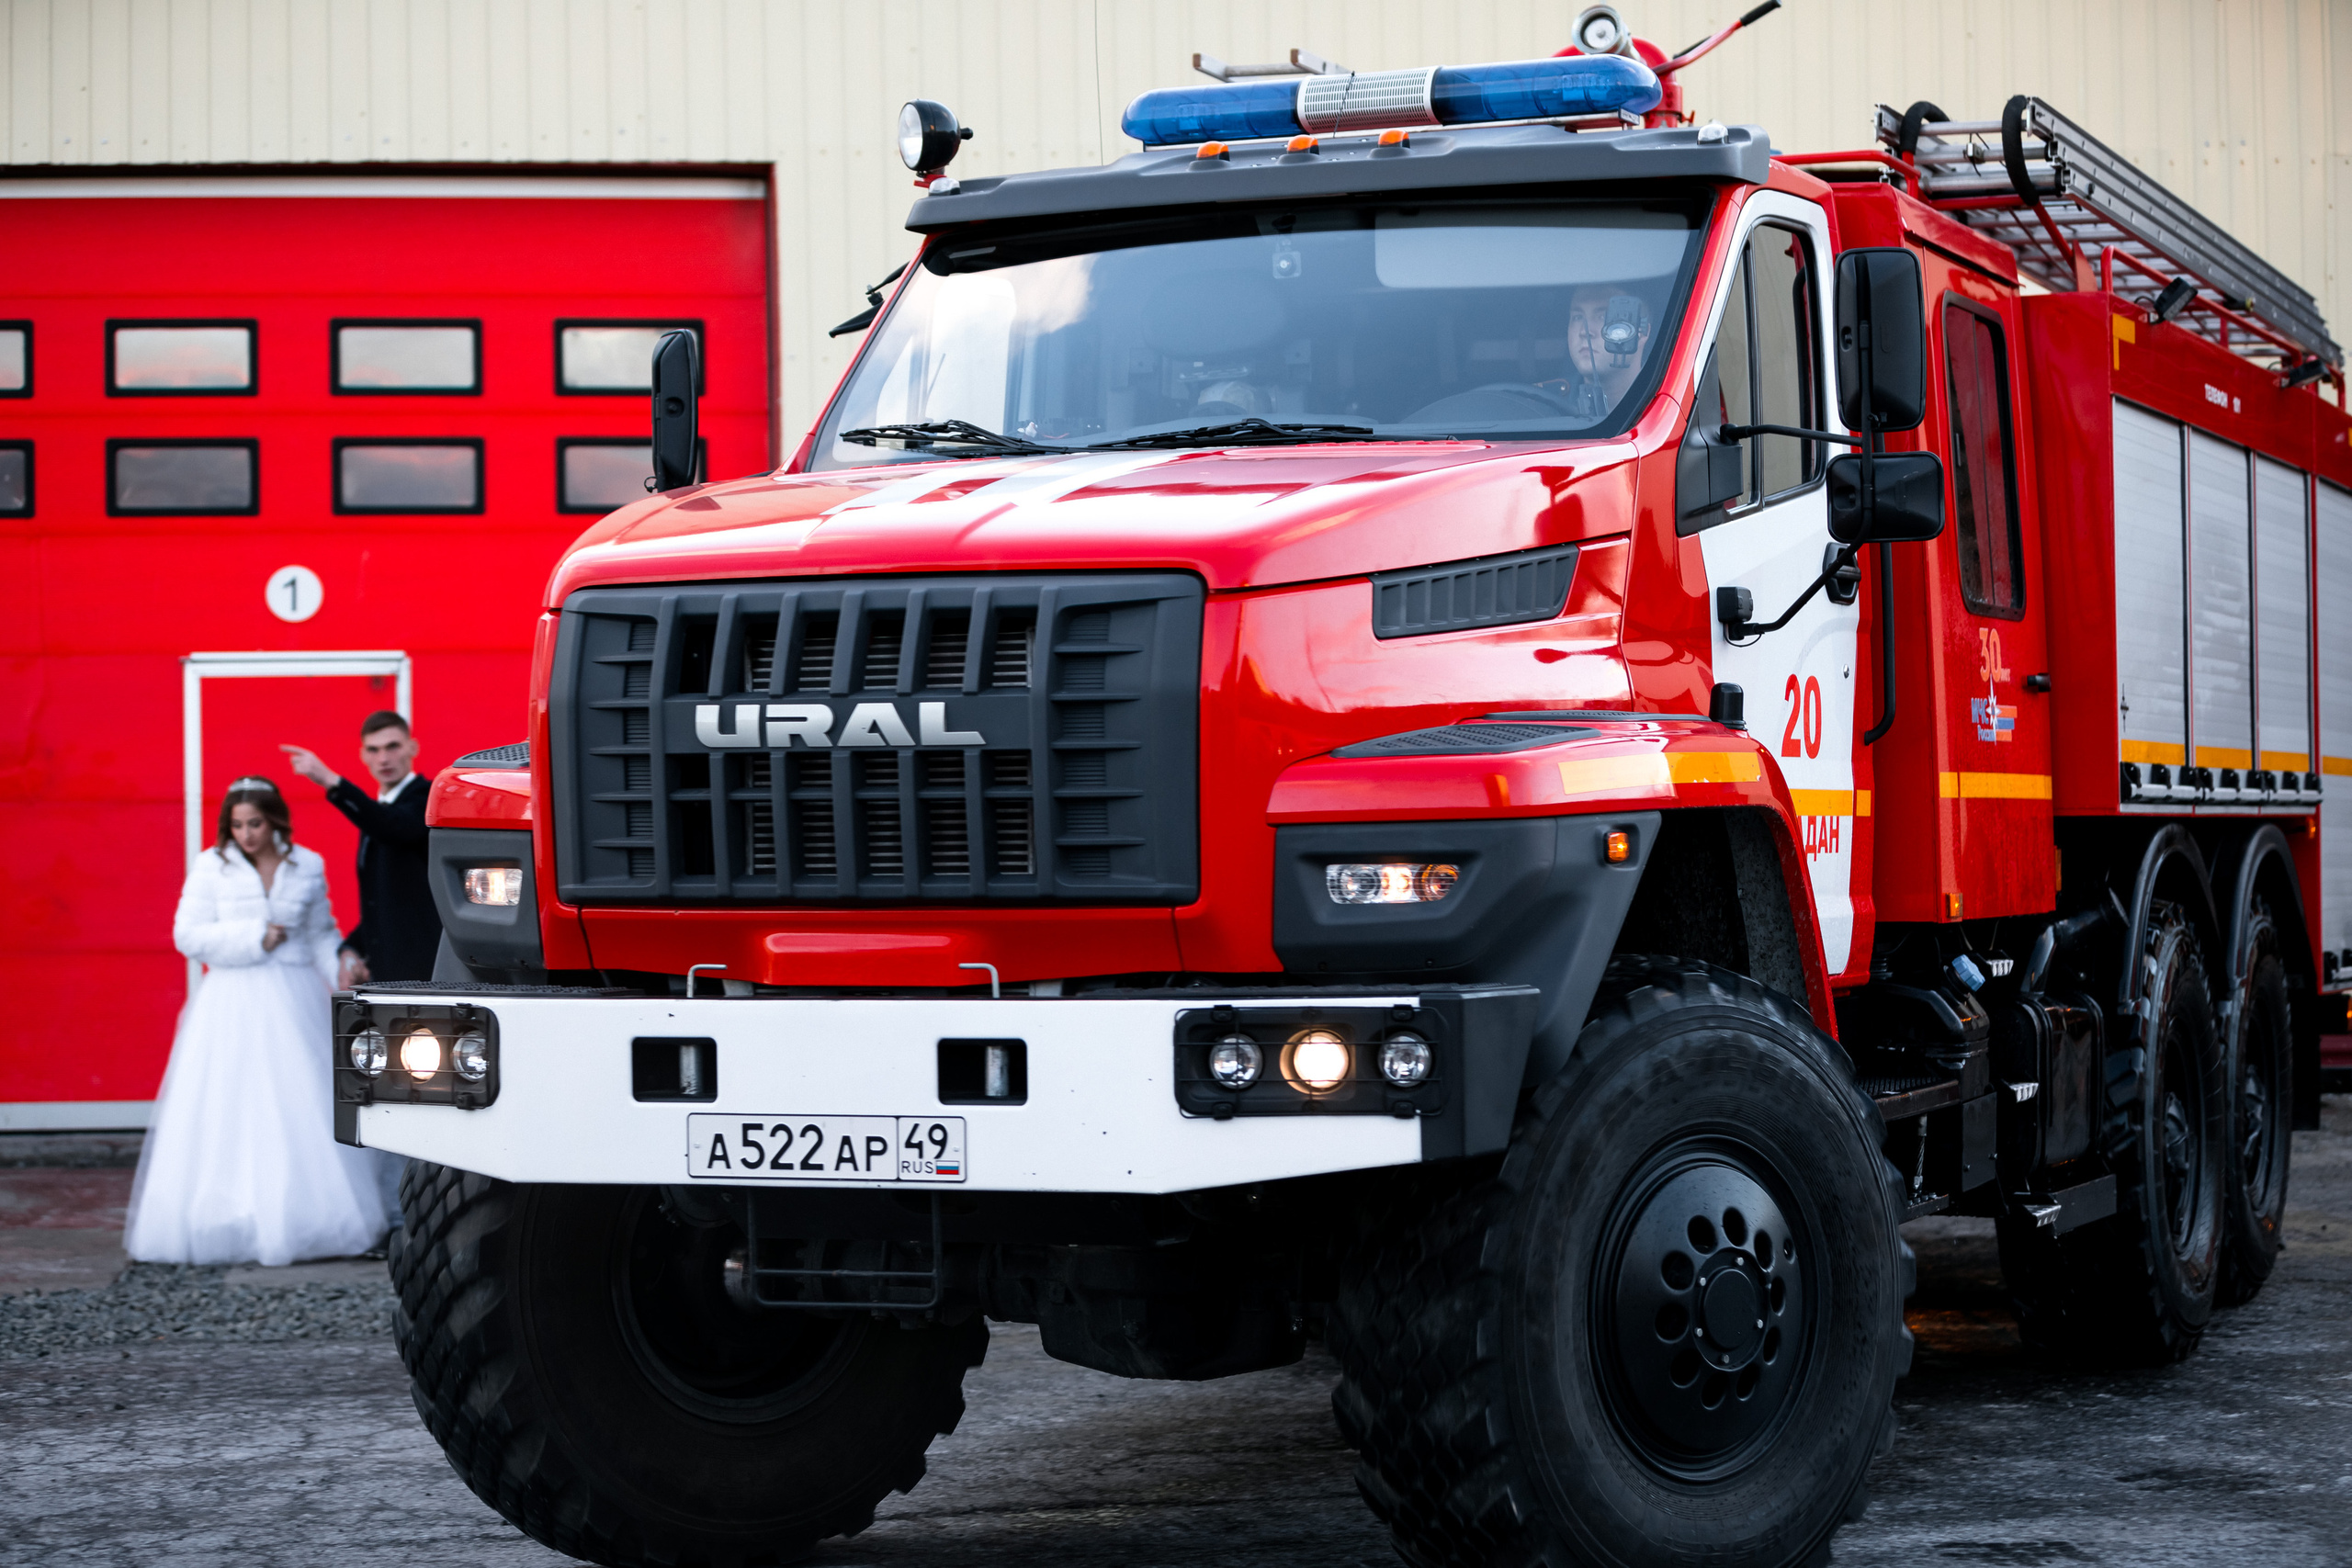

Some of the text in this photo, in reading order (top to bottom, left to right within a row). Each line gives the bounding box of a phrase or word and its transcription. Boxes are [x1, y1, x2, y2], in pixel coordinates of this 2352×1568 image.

[282, 576, 297, 612] 1
[1979, 627, 2001, 682] 30
[695, 702, 987, 748] URAL
[1781, 673, 1822, 760] 20
[1971, 697, 1989, 725] МЧС
[904, 1122, 948, 1159] 49
[900, 1160, 934, 1174] RUS
